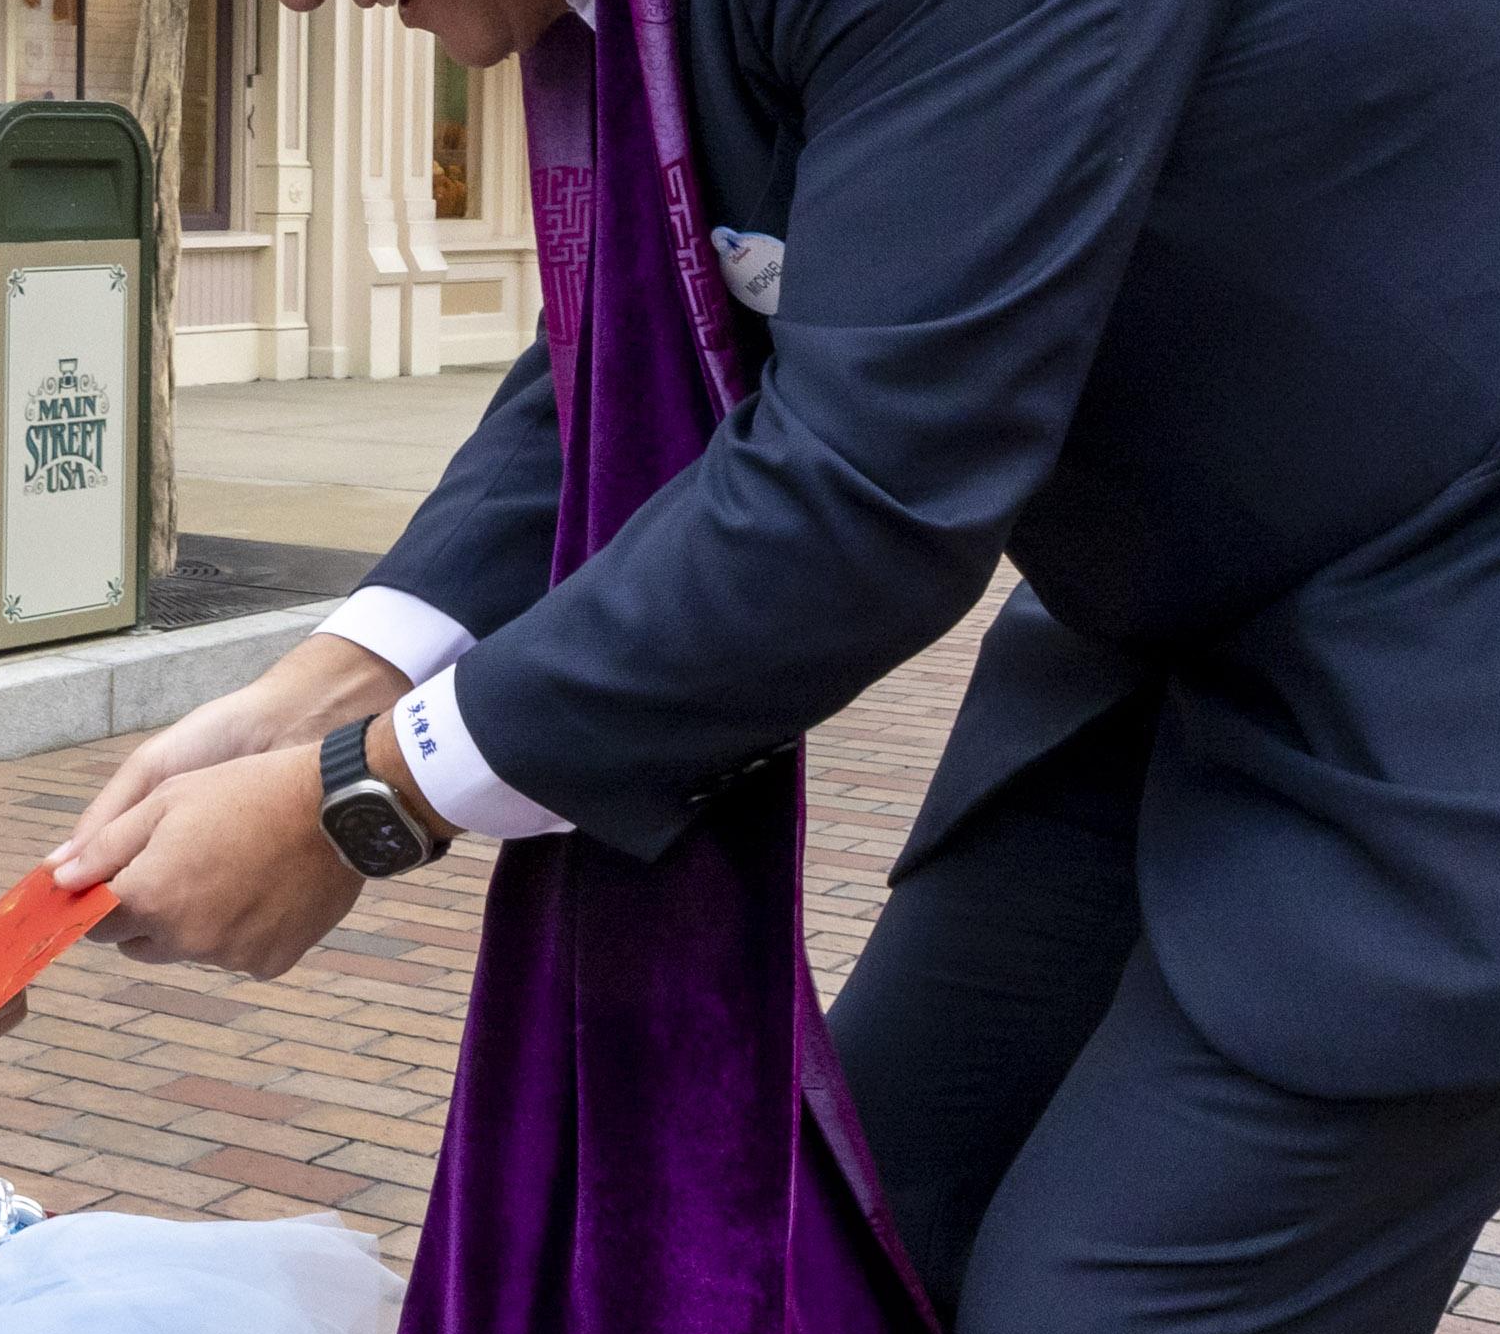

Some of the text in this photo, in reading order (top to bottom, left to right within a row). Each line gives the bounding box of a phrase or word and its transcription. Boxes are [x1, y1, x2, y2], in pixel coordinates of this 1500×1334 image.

[38, 395, 97, 421] MAIN
[25, 418, 107, 483] STREET
[46, 460, 87, 493] USA
